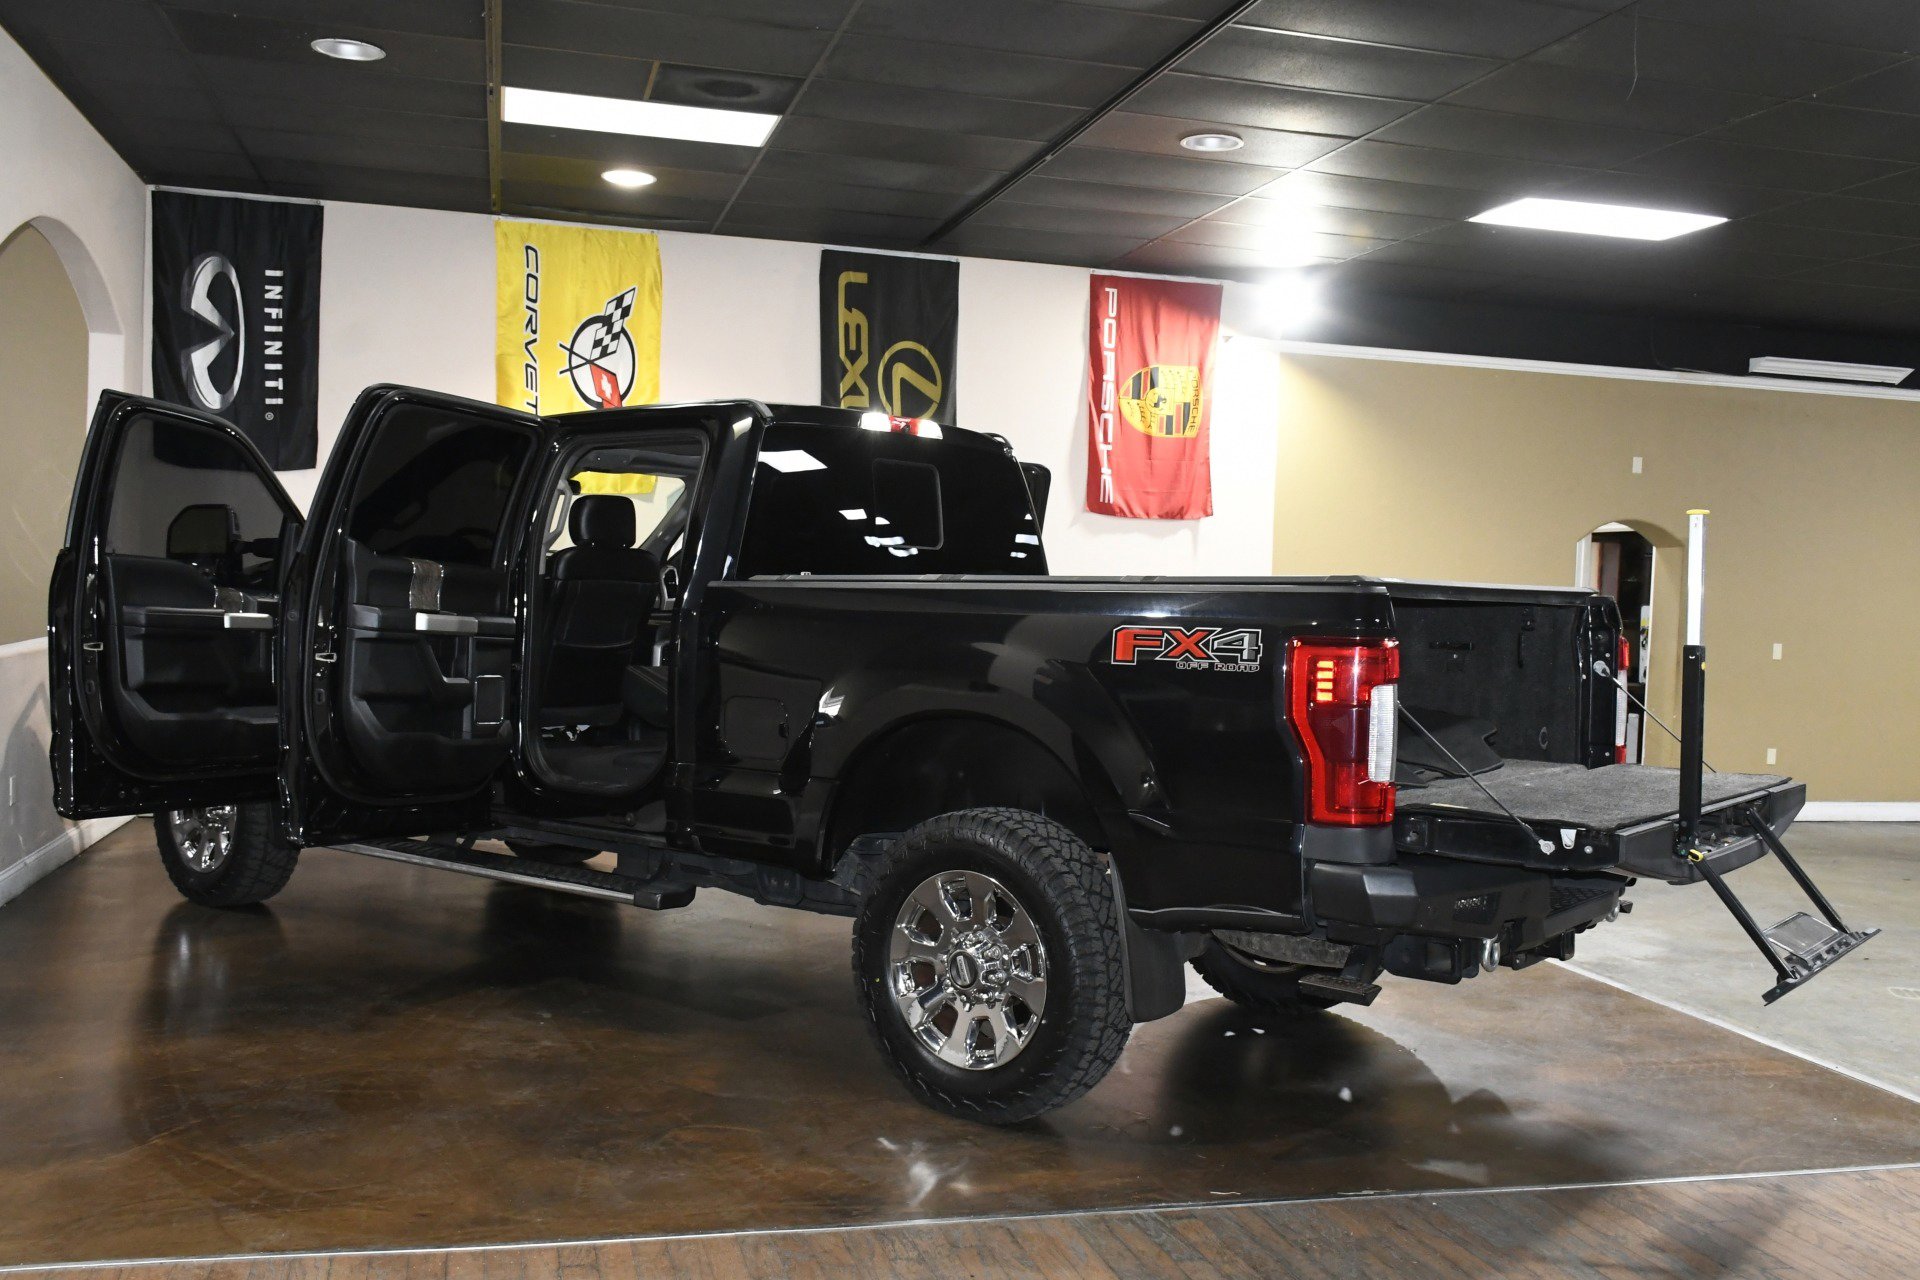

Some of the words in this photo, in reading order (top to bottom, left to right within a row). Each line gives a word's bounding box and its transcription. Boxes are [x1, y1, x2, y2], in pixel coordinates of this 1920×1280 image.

[264, 269, 284, 405] INFINITI
[1100, 287, 1118, 504] PORSCHE
[1111, 625, 1262, 665] FX4
[1176, 661, 1209, 670] OFF
[1214, 663, 1260, 672] ROAD
